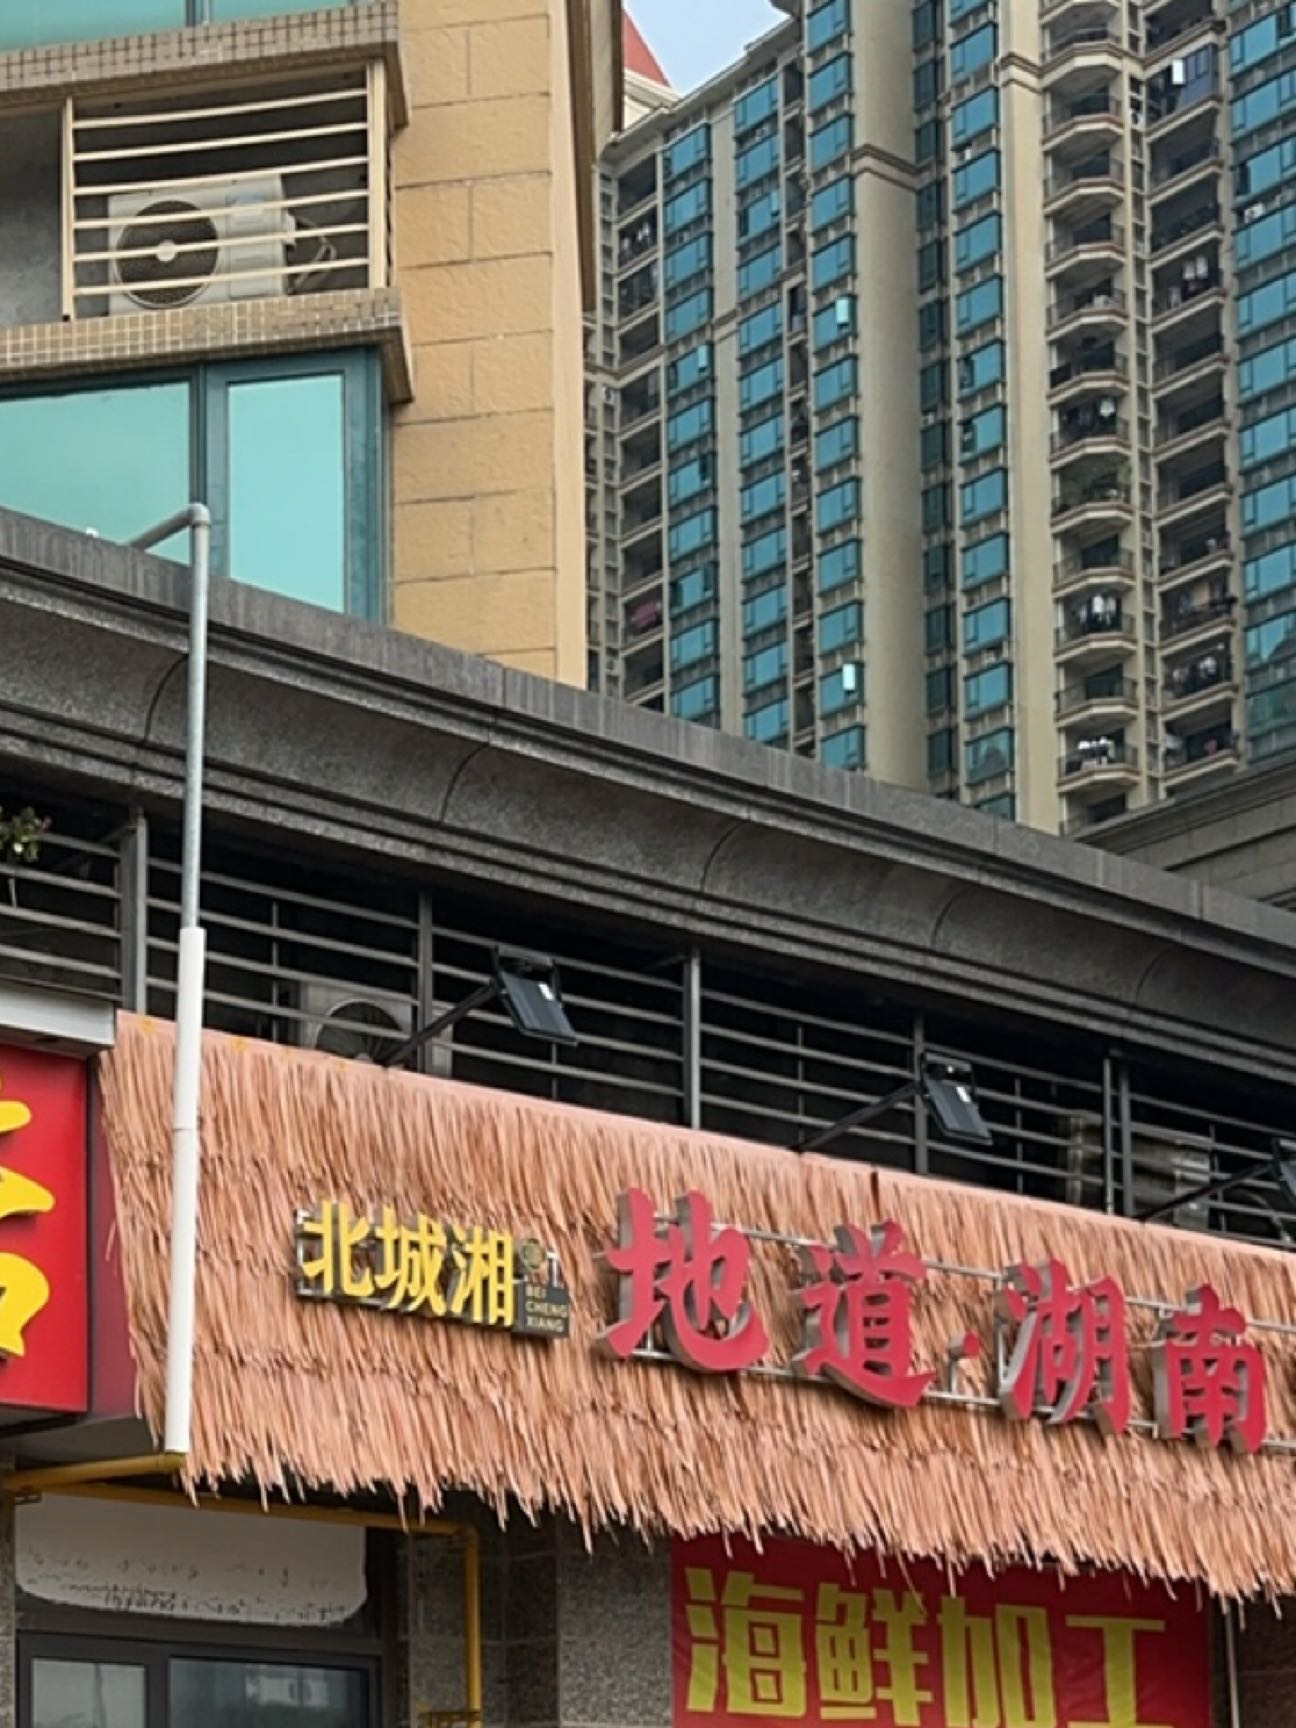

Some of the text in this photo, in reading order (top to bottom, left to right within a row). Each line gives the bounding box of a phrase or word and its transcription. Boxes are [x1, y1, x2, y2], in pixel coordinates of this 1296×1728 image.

[302, 1200, 513, 1327] 北城湘
[525, 1300, 568, 1318] CHENG
[526, 1315, 565, 1332] XIANG
